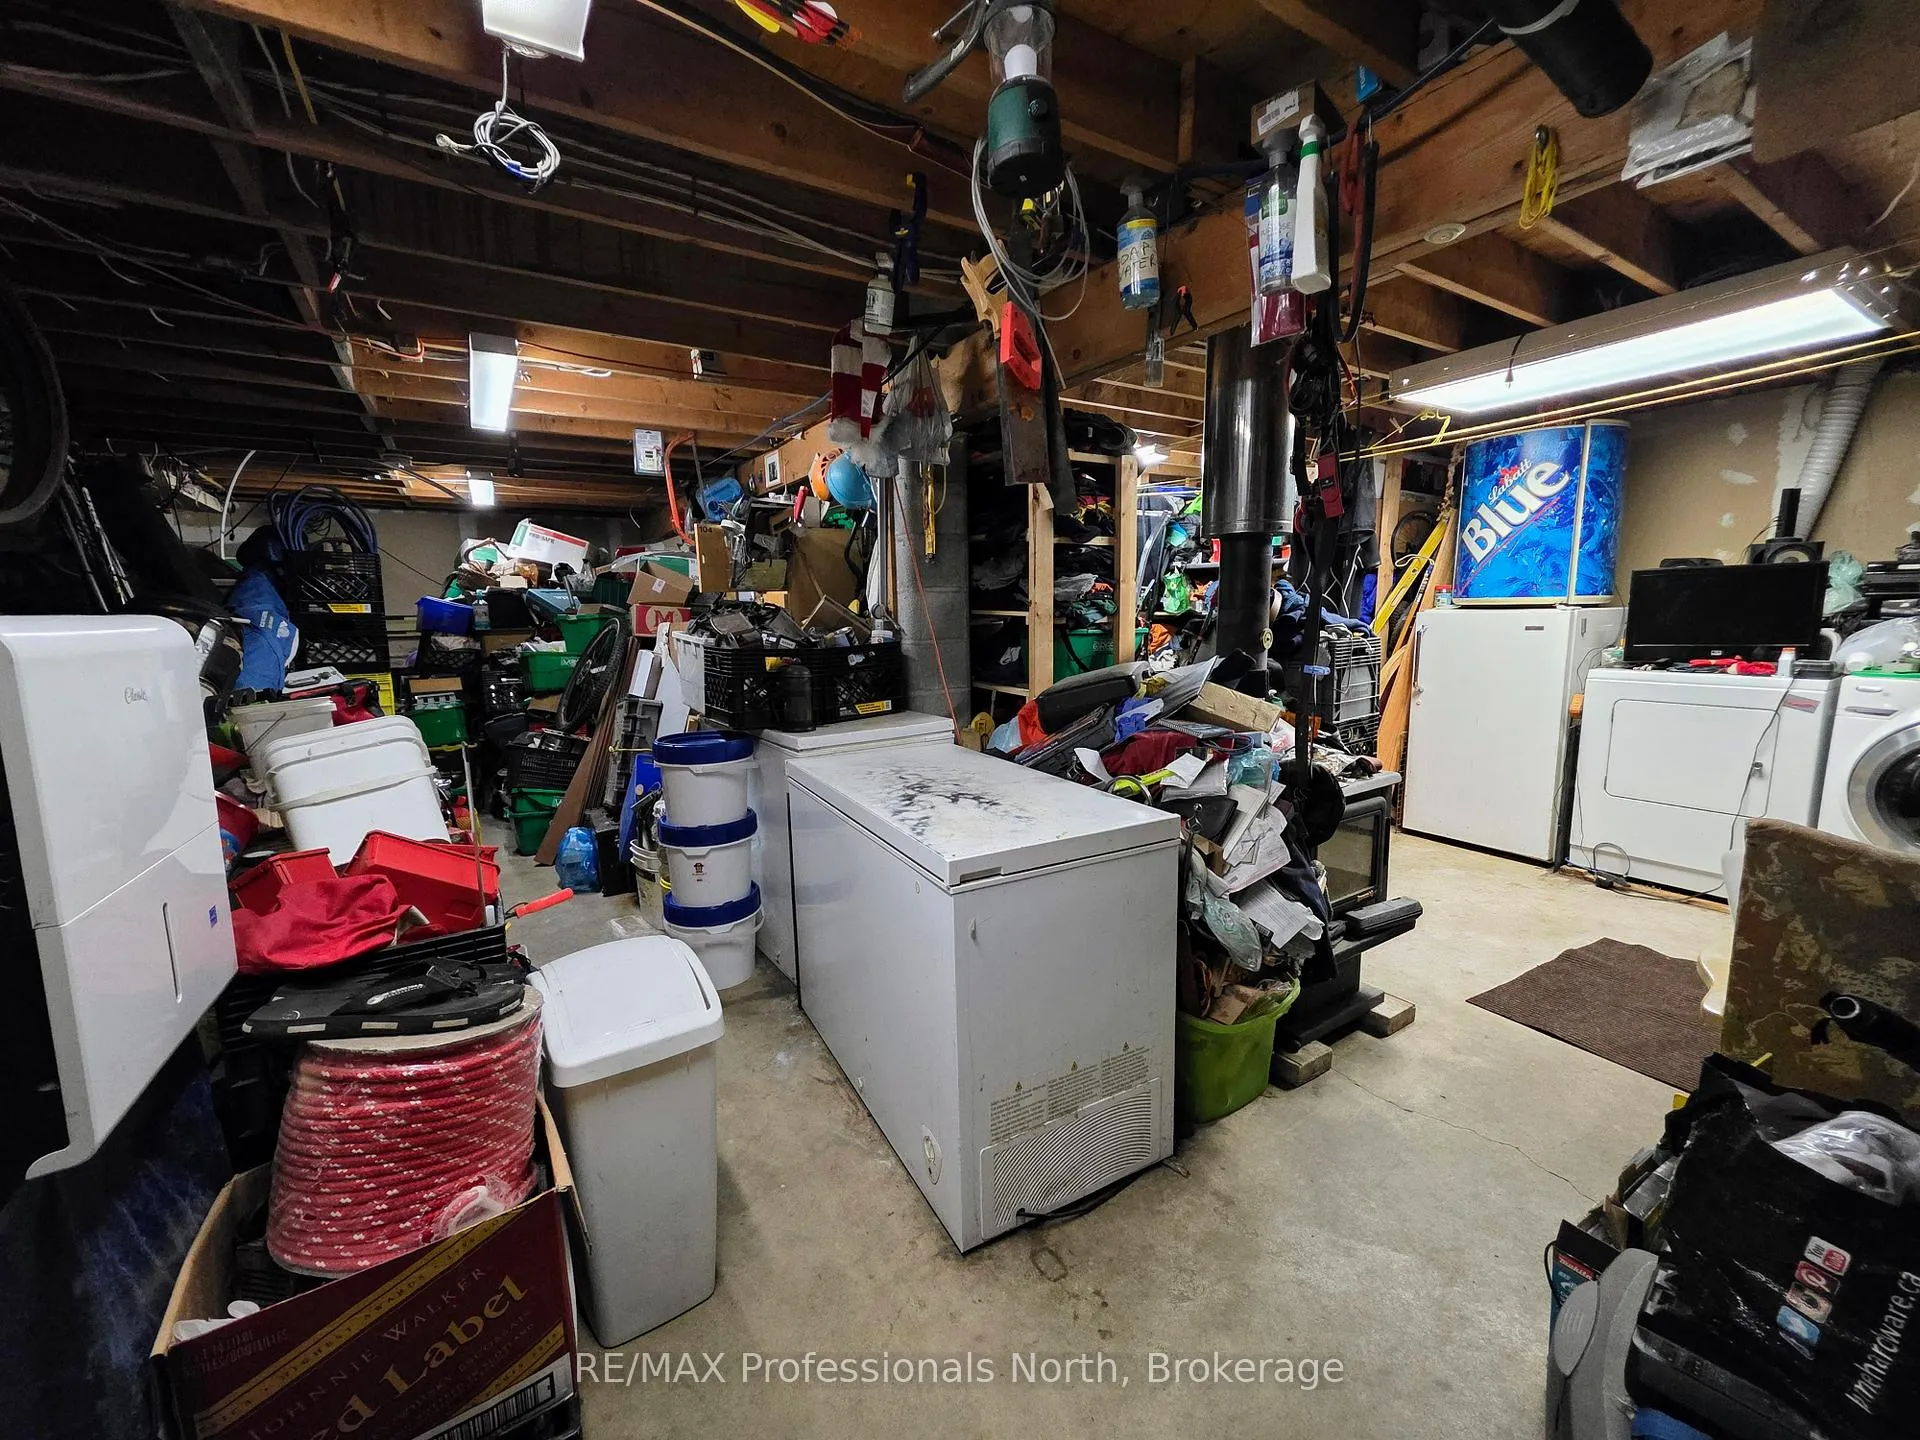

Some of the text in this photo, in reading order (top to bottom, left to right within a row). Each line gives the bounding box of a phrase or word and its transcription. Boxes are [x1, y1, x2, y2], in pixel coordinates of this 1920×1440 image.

[1461, 460, 1571, 564] Blue
[1488, 458, 1532, 505] Labatt
[249, 1349, 378, 1440] JOHNNIE
[383, 1266, 487, 1343] WALKER
[380, 1274, 529, 1395] Label
